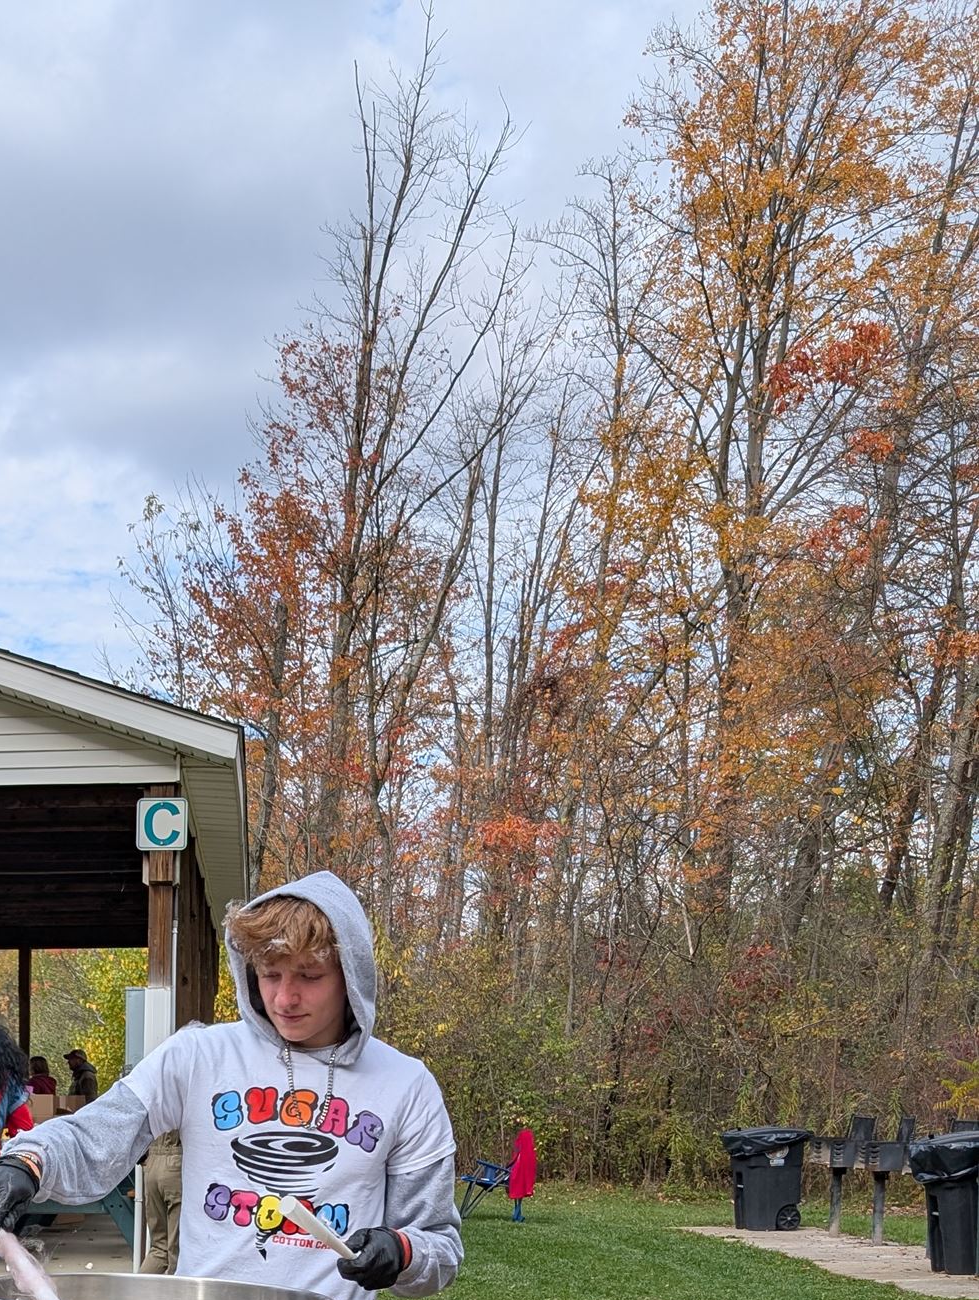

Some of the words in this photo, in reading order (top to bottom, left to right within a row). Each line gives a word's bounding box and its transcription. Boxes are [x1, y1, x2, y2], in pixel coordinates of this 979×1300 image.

[144, 801, 181, 846] C
[212, 1087, 384, 1152] SUGAR
[273, 1235, 314, 1248] COTTON
